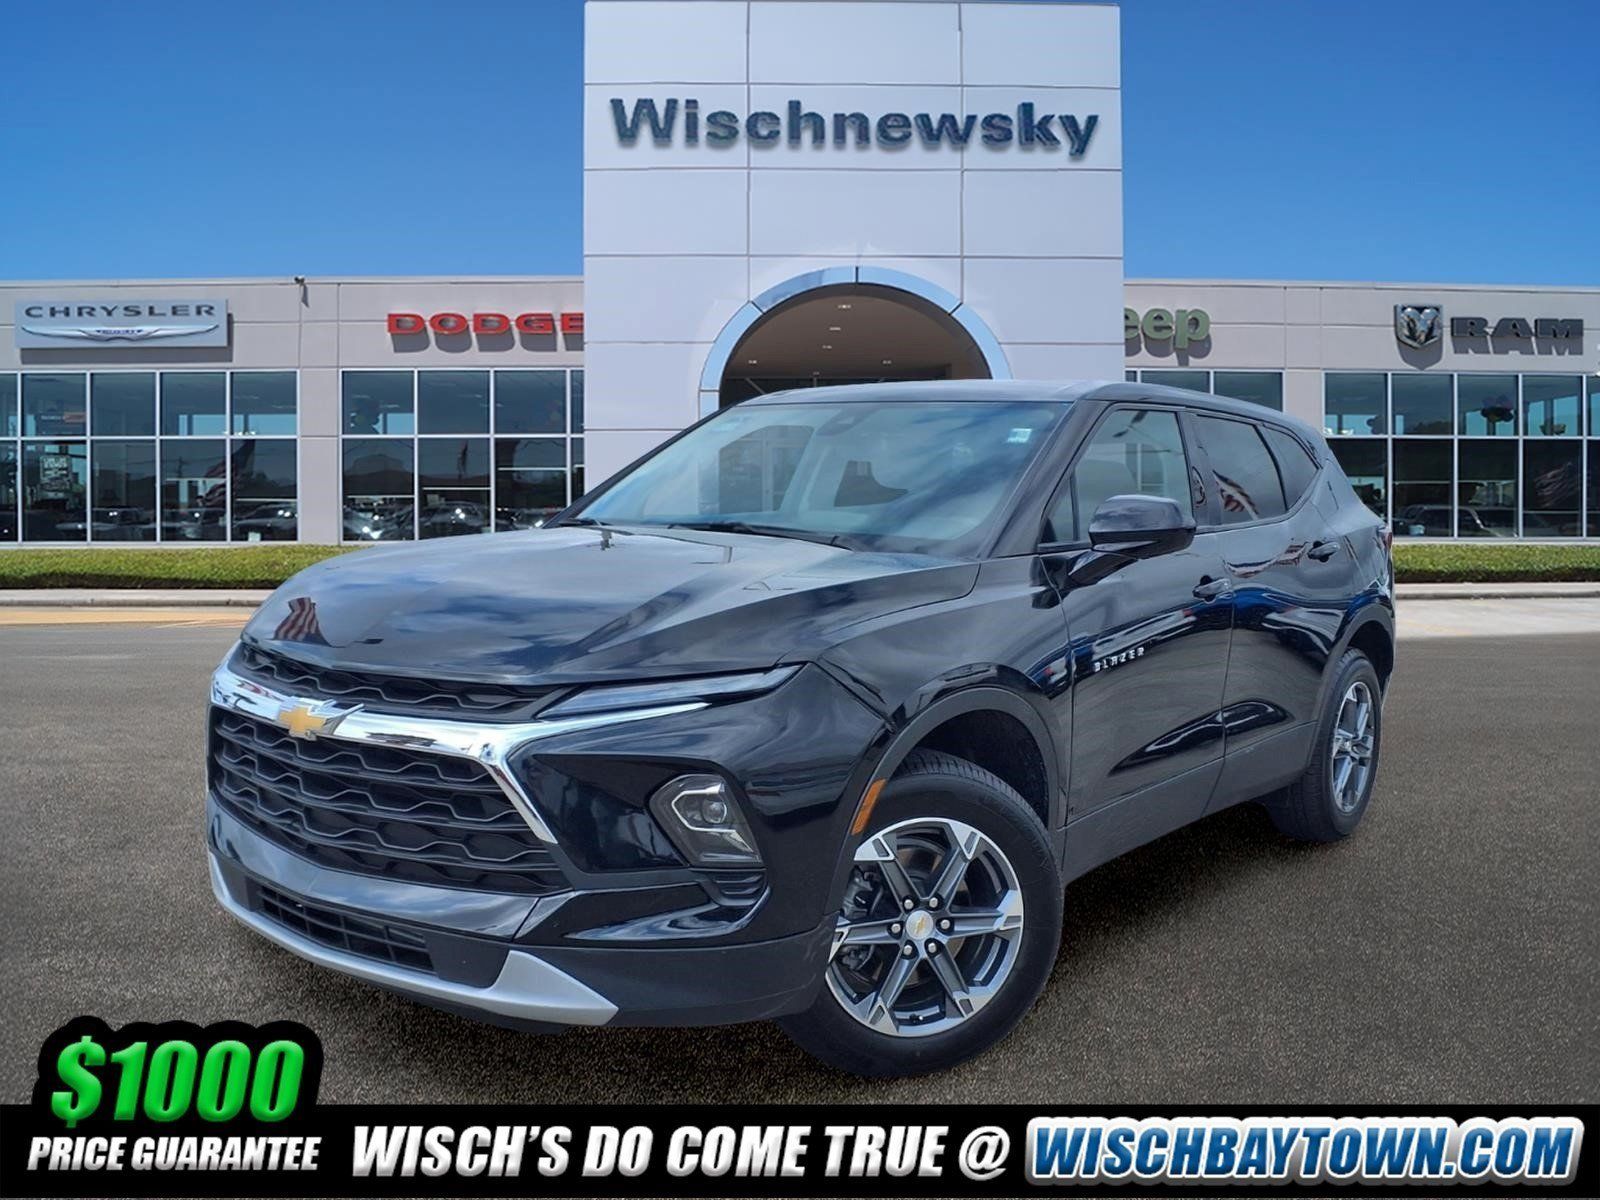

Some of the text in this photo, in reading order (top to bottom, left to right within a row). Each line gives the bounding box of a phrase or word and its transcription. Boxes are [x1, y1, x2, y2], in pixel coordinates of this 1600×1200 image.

[610, 97, 1099, 158] Wischnewsky
[24, 303, 217, 318] CHRYSLER
[387, 312, 584, 335] DODGE
[1451, 317, 1584, 338] RAM
[1093, 647, 1145, 673] BLAZER
